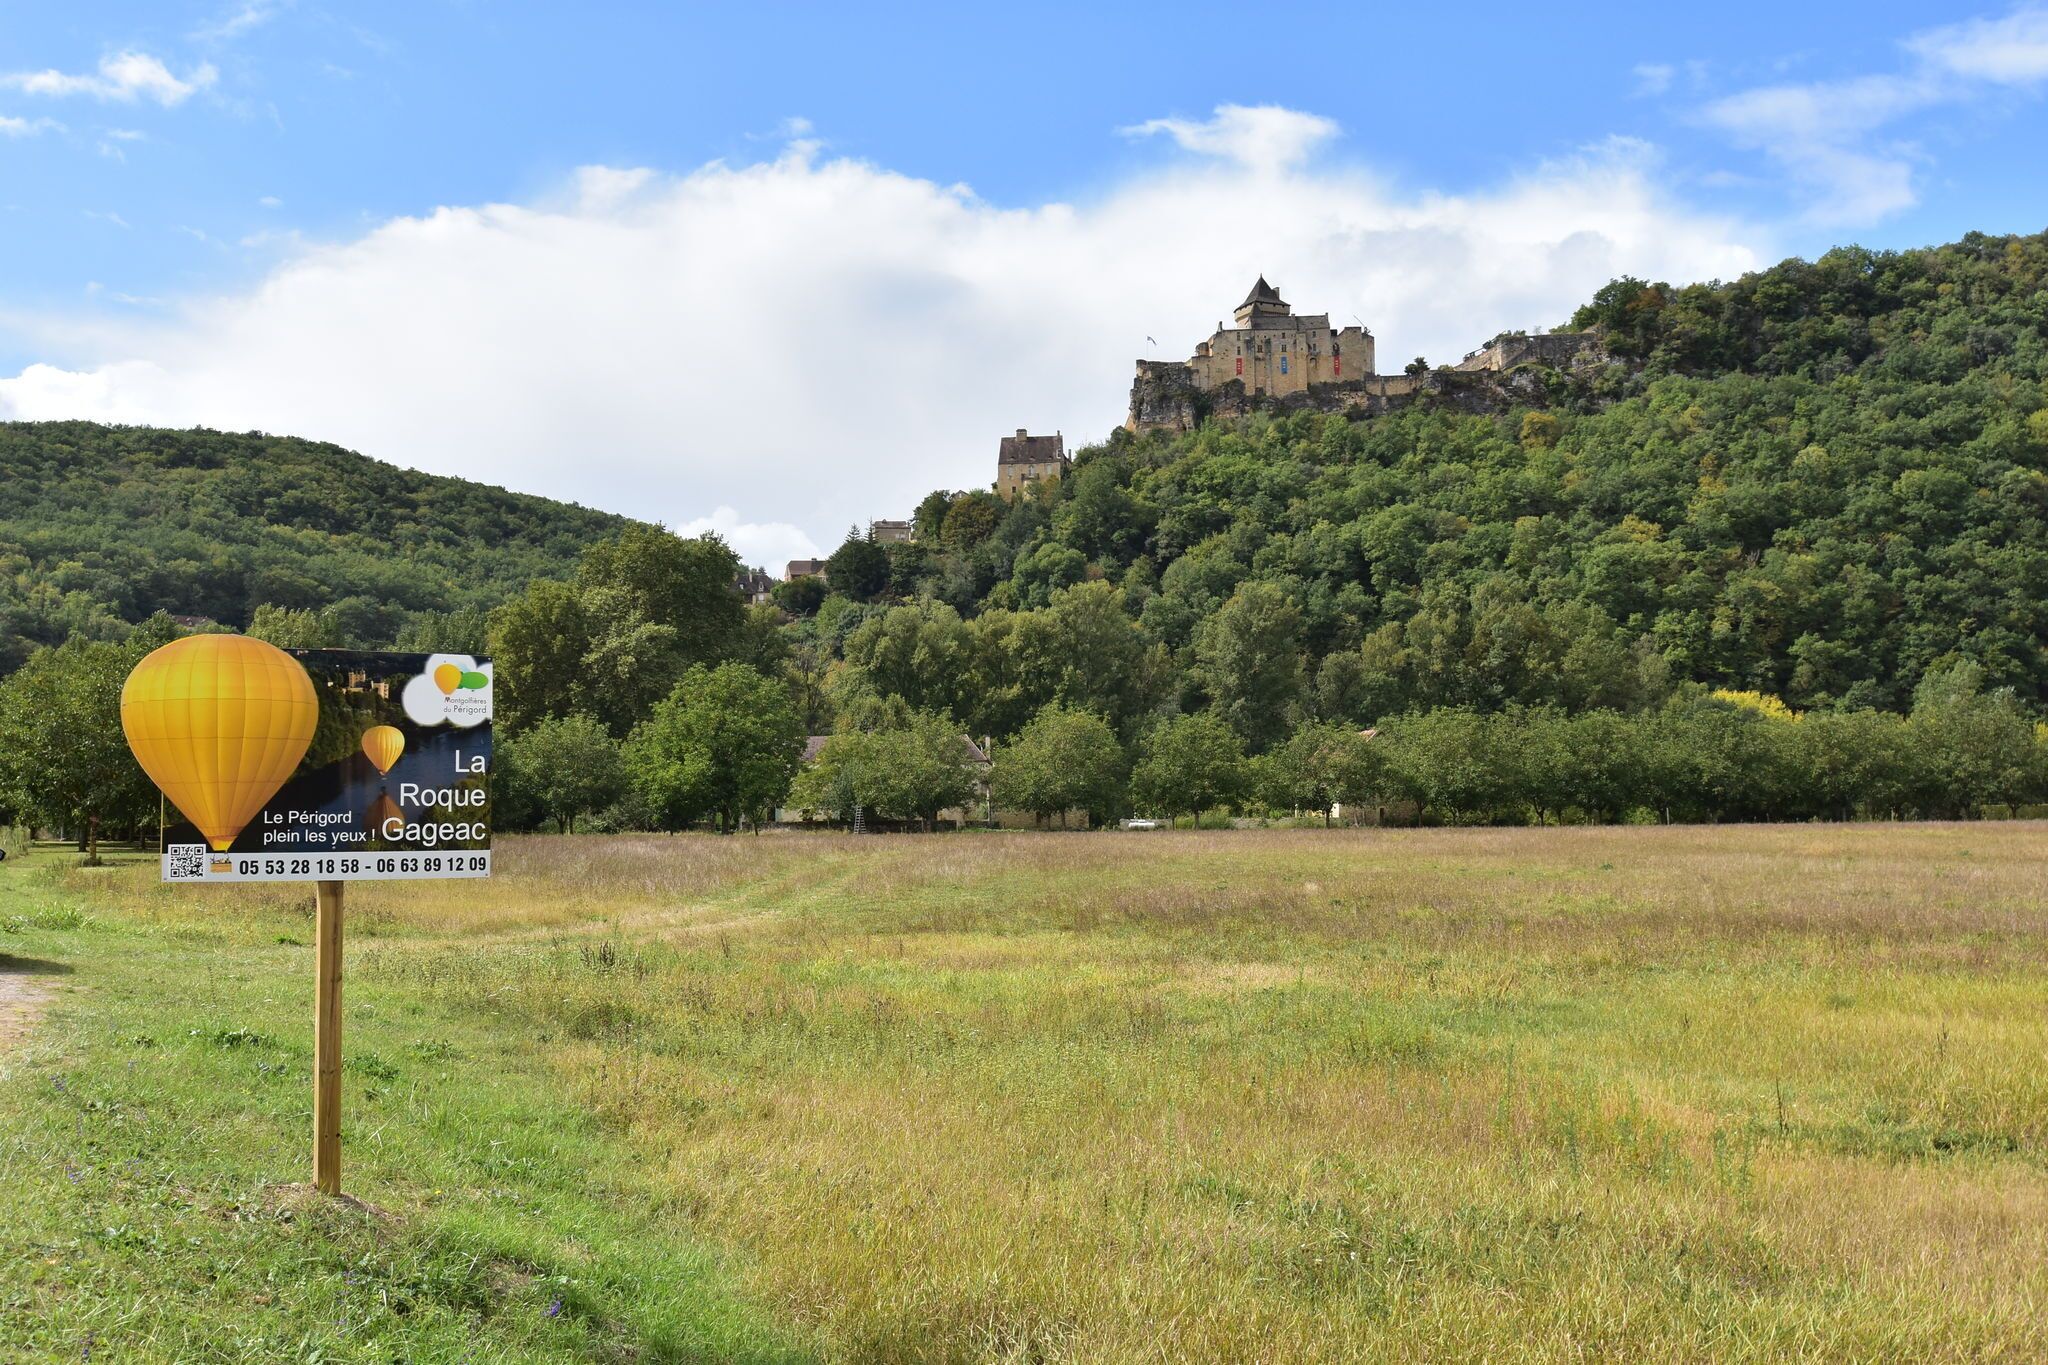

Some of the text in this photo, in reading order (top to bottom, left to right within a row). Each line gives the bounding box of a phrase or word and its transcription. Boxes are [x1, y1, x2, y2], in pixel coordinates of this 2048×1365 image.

[445, 696, 487, 705] Montgolfières
[453, 705, 487, 715] Périgord
[456, 750, 485, 773] La
[400, 784, 485, 812] Roque
[264, 811, 351, 828] Le Périgord
[264, 829, 300, 845] plein
[305, 829, 326, 842] les
[331, 832, 366, 845] yeux
[382, 818, 485, 846] Gageac
[240, 860, 258, 874] 05
[265, 860, 284, 874] 53
[291, 860, 309, 874] 28
[317, 860, 334, 873] 18
[341, 859, 359, 873] 58
[377, 859, 395, 872] 06
[401, 858, 418, 872] 63
[424, 858, 441, 871] 89
[447, 857, 464, 871] 12
[469, 857, 486, 870] 09
